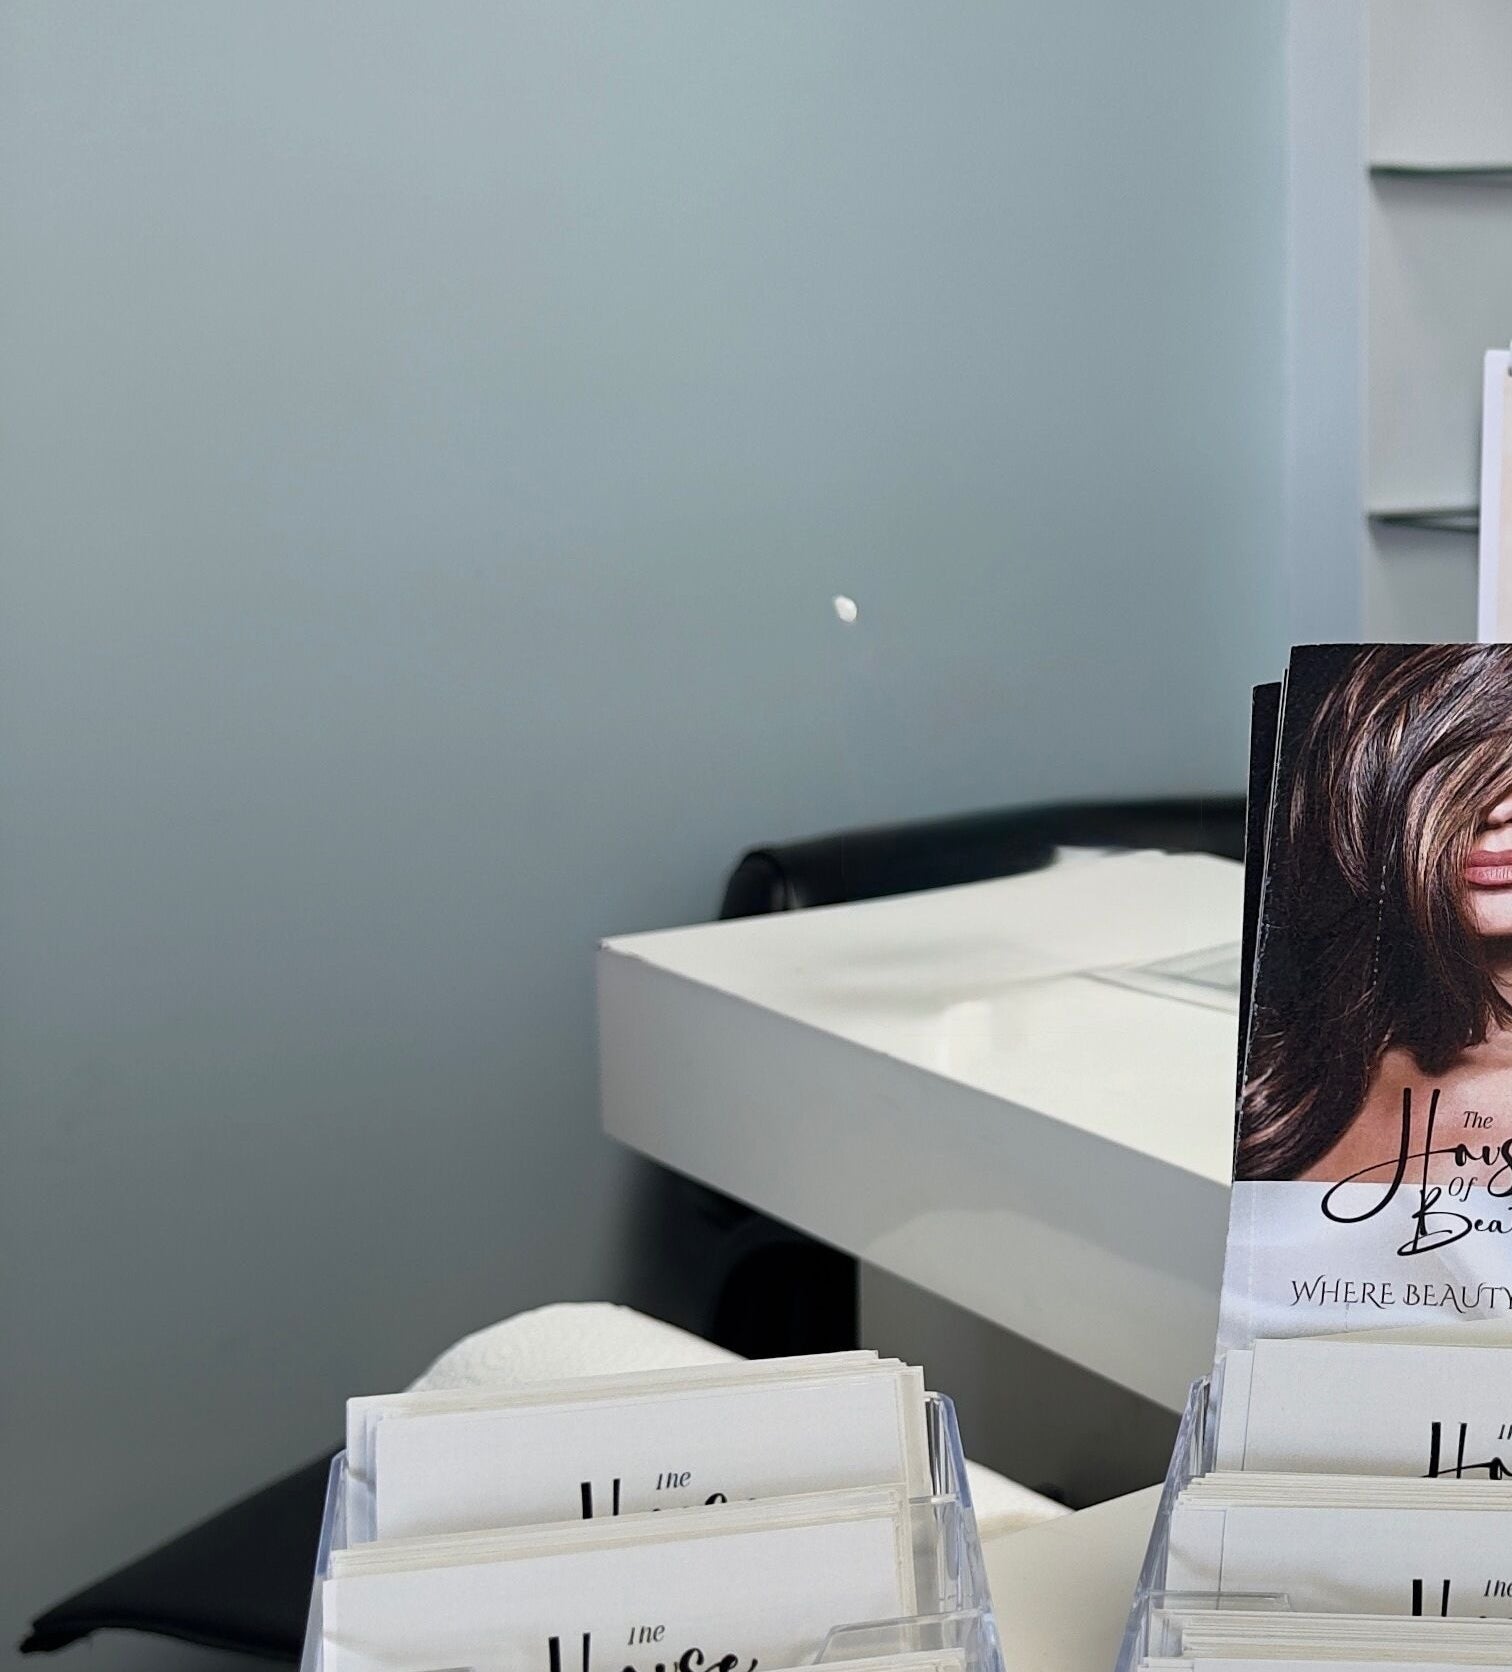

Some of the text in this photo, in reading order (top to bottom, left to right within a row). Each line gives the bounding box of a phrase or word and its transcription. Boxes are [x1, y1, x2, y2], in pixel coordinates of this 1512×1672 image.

[1462, 1110, 1494, 1130] The
[1447, 1175, 1478, 1203] Of
[1289, 1274, 1395, 1309] WHERE
